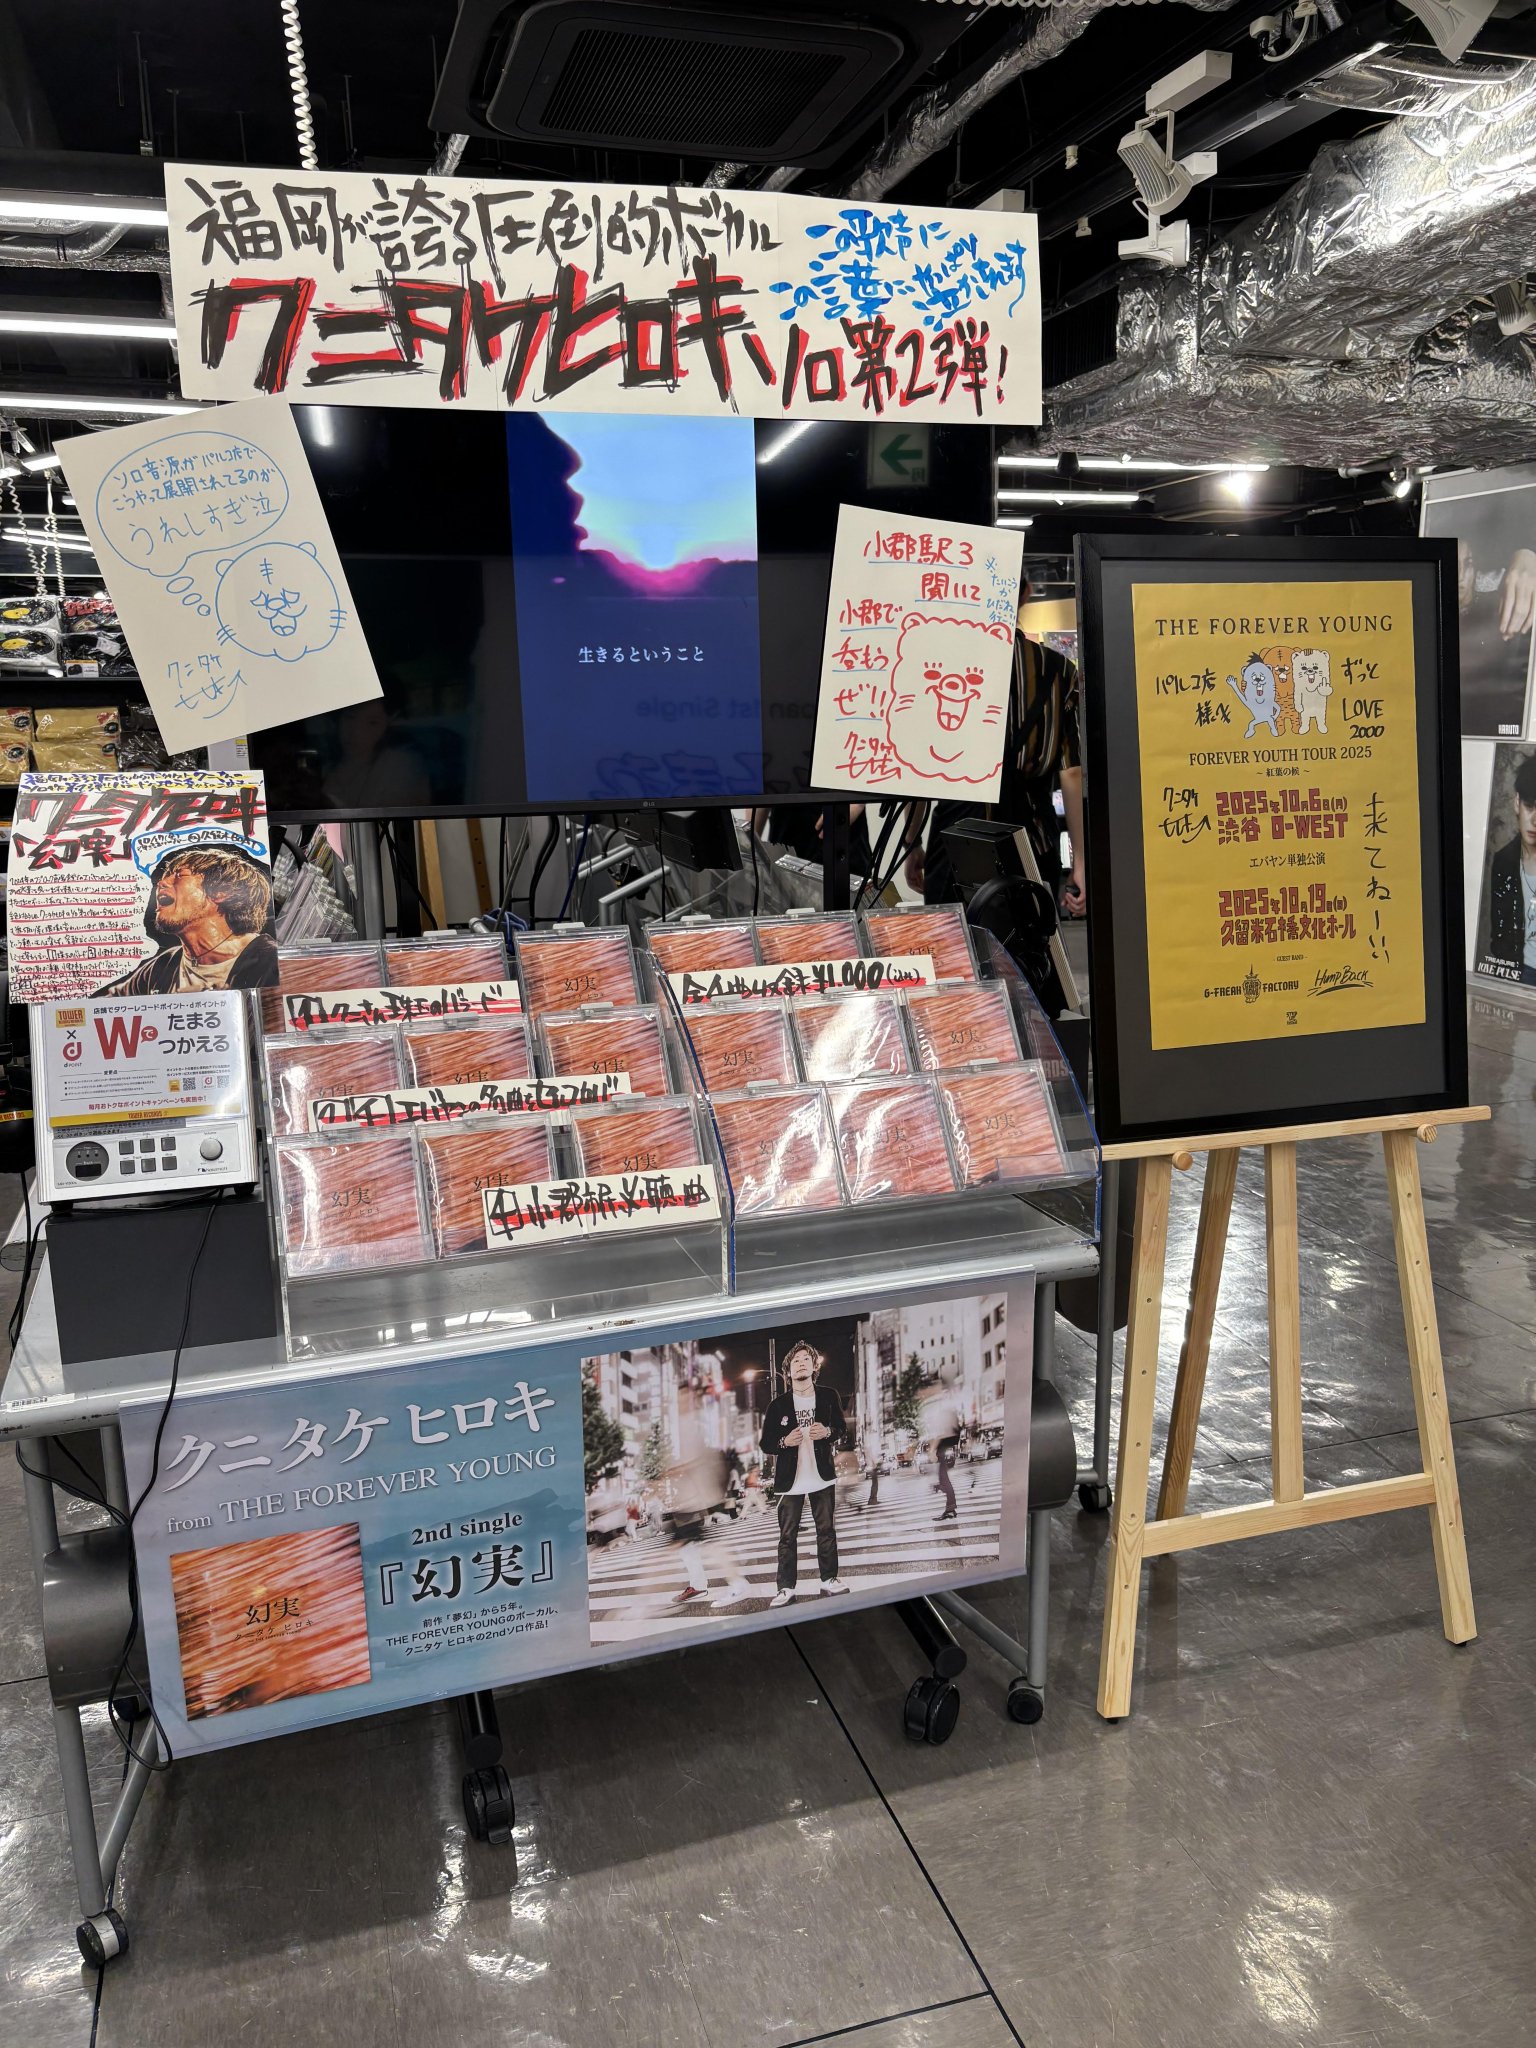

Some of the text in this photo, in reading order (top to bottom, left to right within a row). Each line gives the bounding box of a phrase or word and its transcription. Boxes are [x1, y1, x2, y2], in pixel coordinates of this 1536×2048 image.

[1156, 615, 1393, 636] THE FOREVER YOUNG
[578, 646, 705, 663] 生きるということ
[1343, 698, 1384, 721] LOVE
[1350, 724, 1385, 740] 2000
[1189, 745, 1372, 766] FOREVER YOUTH TOUR 2025
[1217, 813, 1348, 845] 渋谷 O-WEST
[1250, 851, 1326, 868] エバヤン単独公演
[1220, 914, 1357, 947] 久留米石橋文化ホール
[564, 975, 597, 992] 幻実
[1263, 980, 1299, 993] FACTORY
[58, 1009, 84, 1021] TOWER
[167, 1011, 222, 1031] たまる
[93, 1015, 143, 1060] W
[158, 1034, 230, 1055] つかえる
[949, 1030, 980, 1046] 幻実
[723, 1051, 755, 1067] 幻実
[984, 1114, 1016, 1131] 幻実
[332, 1187, 371, 1207] 幻実
[162, 1381, 556, 1493] クニタケ ヒロキ
[167, 1446, 557, 1533] from THE FOREVER YOUNG
[411, 1511, 523, 1547] 2nd single
[379, 1540, 555, 1606] 『幻実』
[245, 1597, 300, 1626] 幻実
[422, 1601, 523, 1628] 前作「夢幻」から5年。
[386, 1636, 409, 1647] THE
[412, 1624, 466, 1643] FOREVER
[405, 1641, 443, 1656] クニタケ
